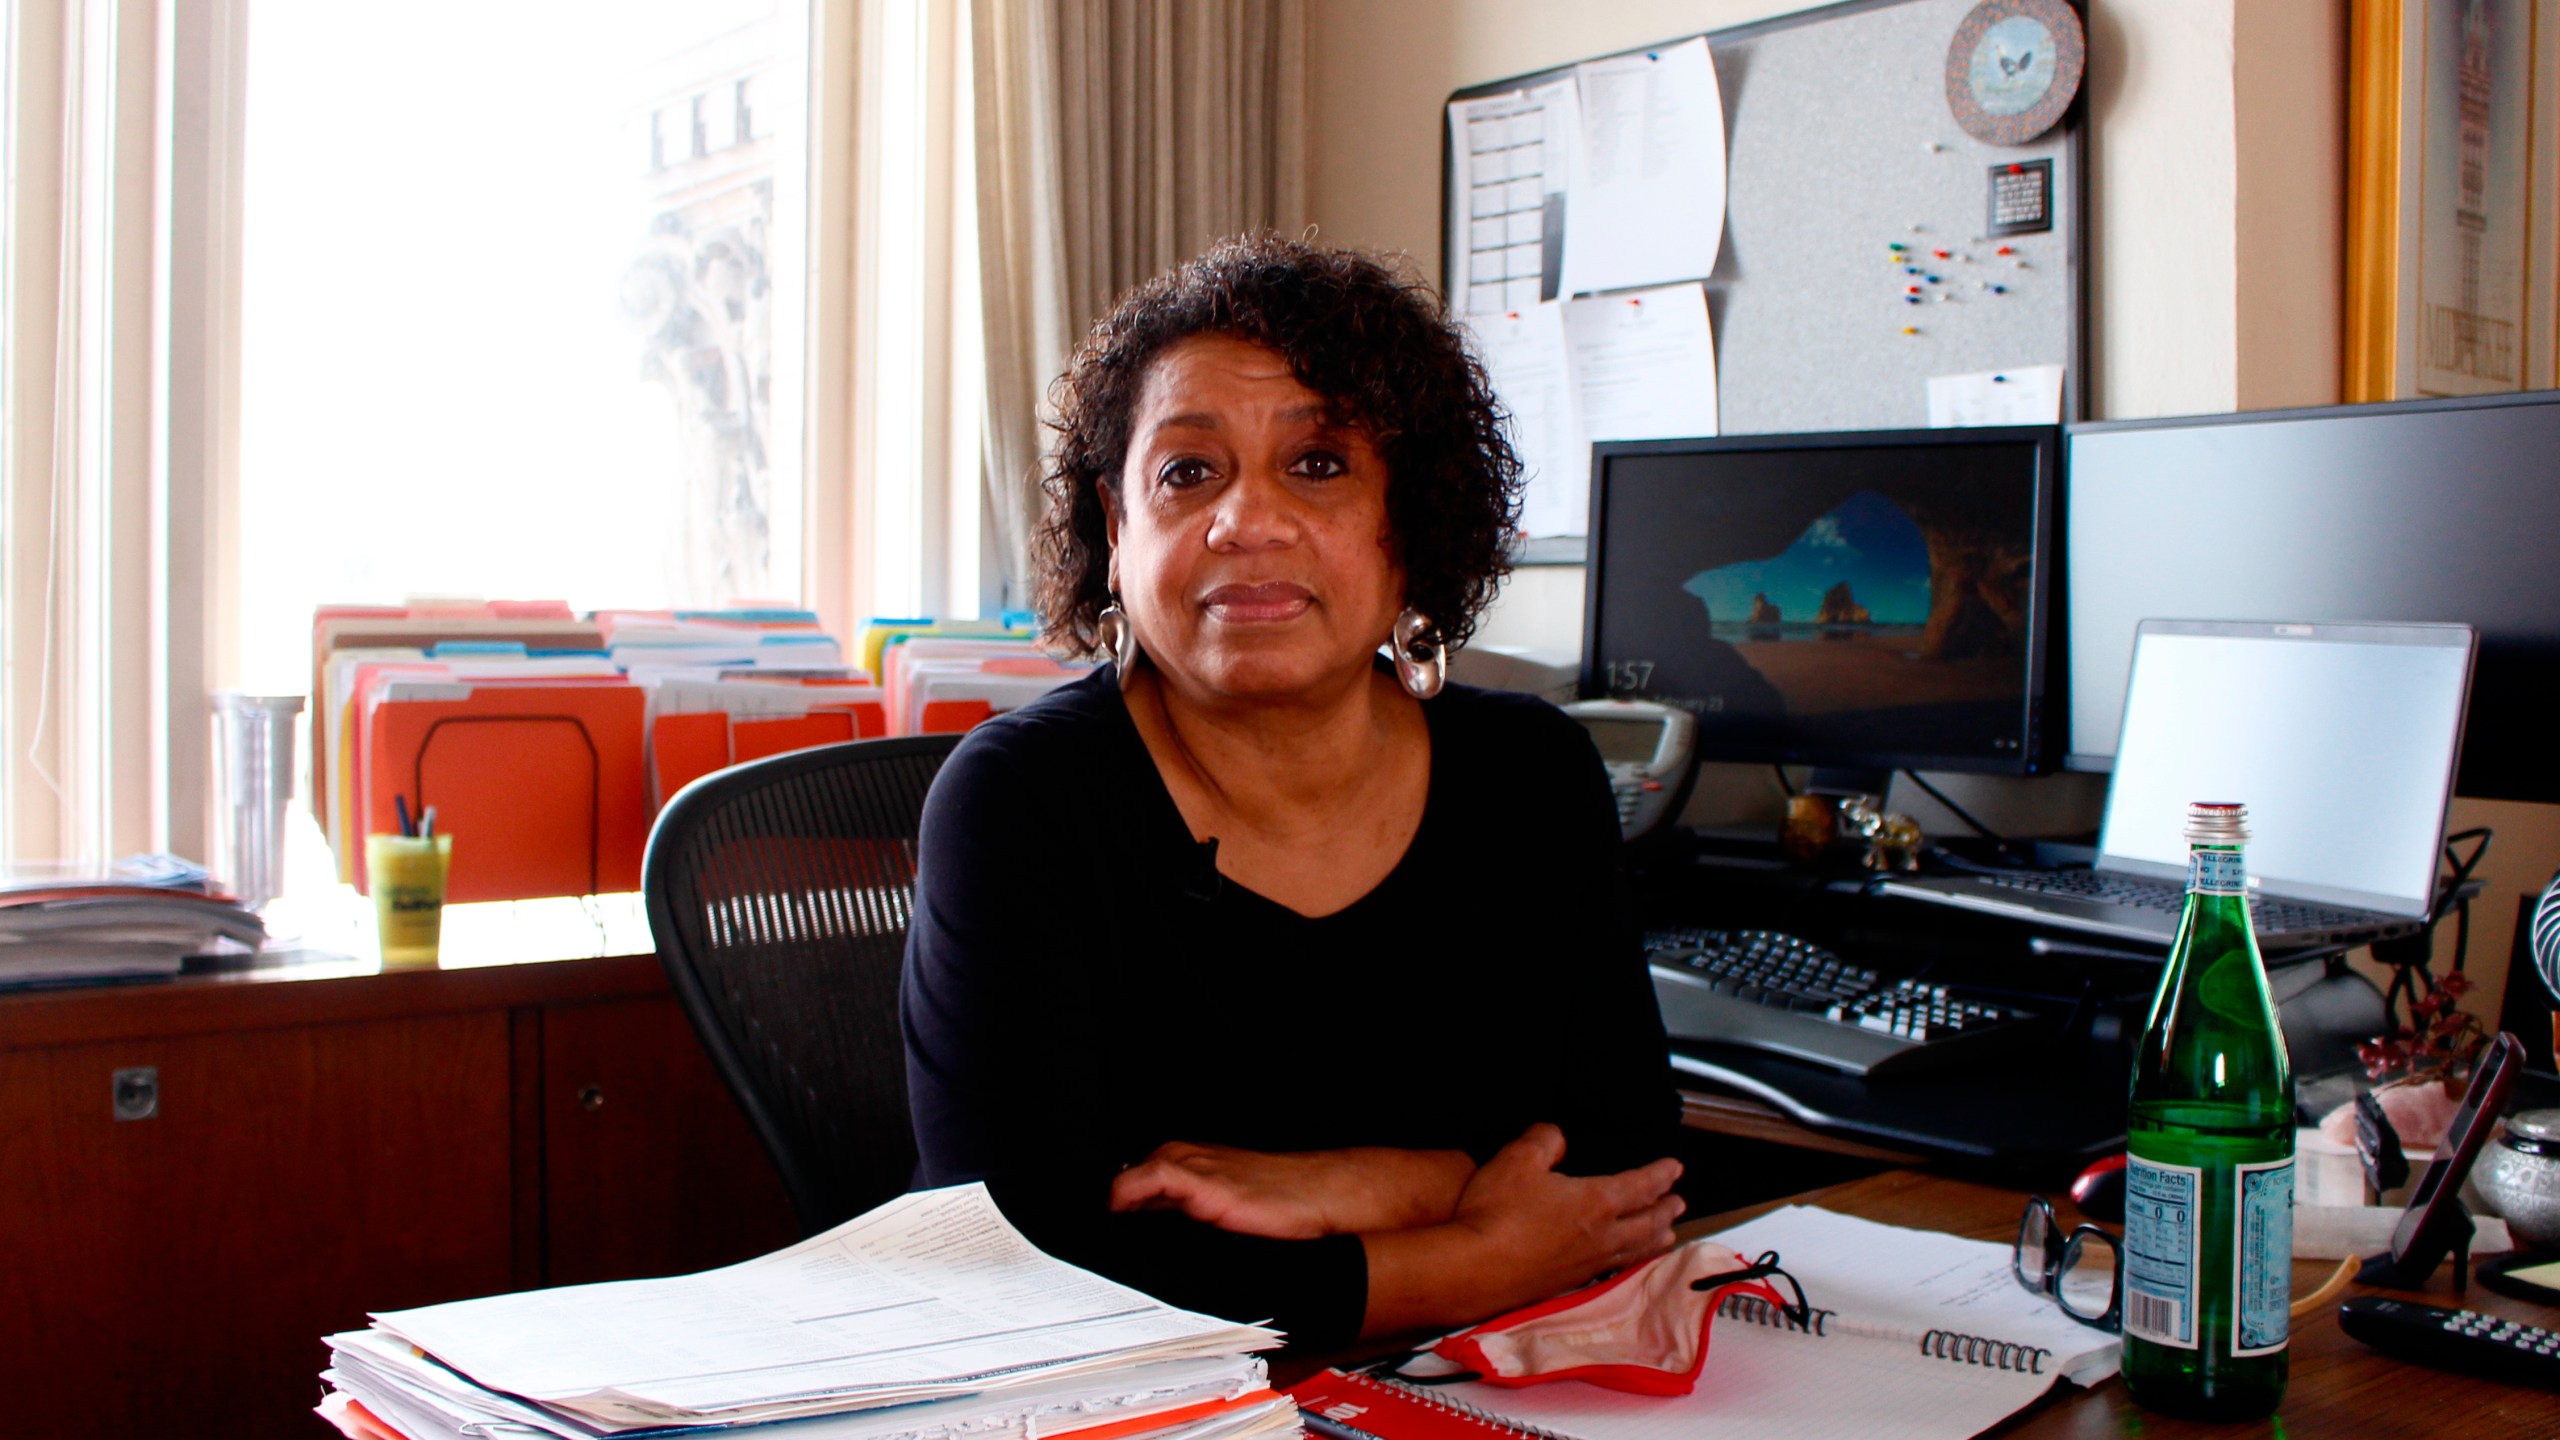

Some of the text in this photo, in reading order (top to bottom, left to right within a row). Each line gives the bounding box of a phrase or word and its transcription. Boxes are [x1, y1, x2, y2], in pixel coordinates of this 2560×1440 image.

[1606, 660, 1656, 691] 1:57
[2200, 854, 2244, 864] ELLEGRIN
[2159, 1171, 2187, 1187] Facts
[2154, 1205, 2164, 1220] 0
[2176, 1209, 2186, 1224] 0
